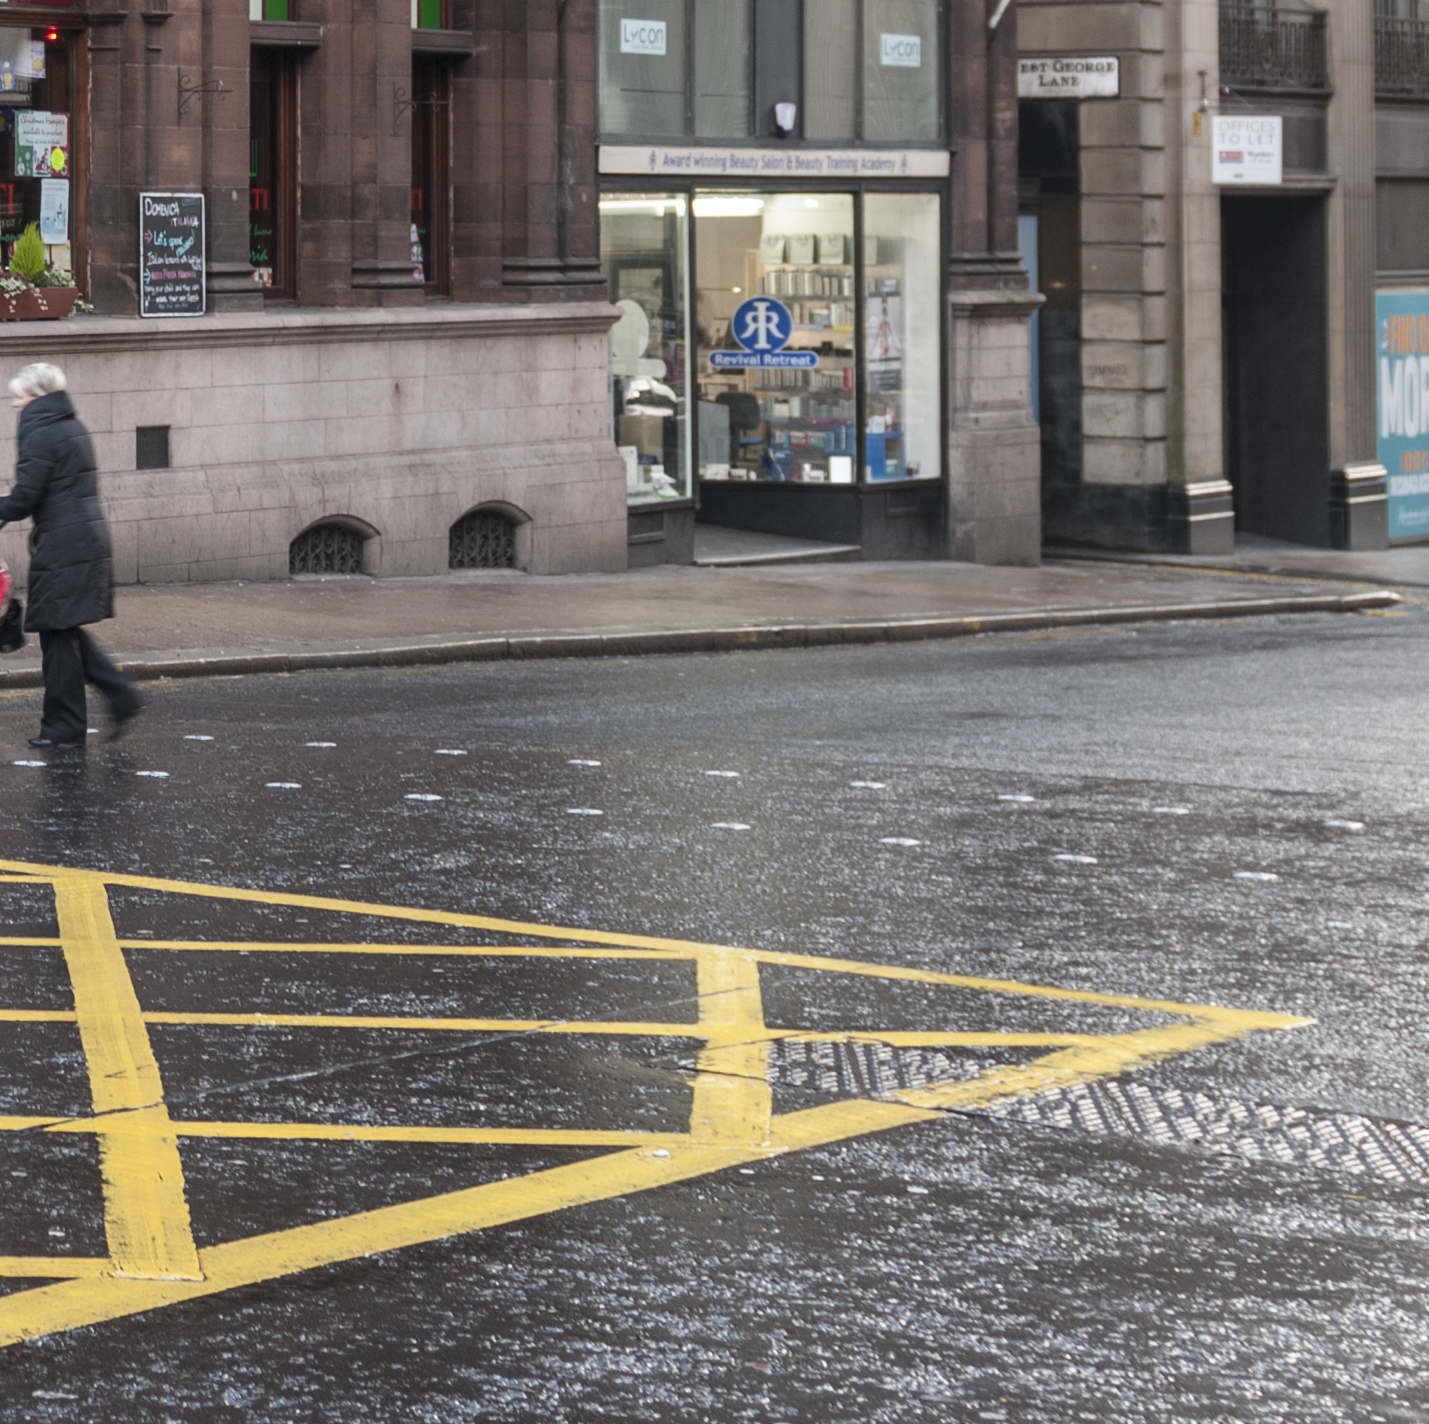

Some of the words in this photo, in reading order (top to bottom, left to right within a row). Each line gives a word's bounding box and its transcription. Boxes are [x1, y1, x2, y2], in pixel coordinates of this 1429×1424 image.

[1053, 60, 1115, 74] GEORGE
[1038, 74, 1080, 87] LANE
[1219, 120, 1276, 133] OFFICES
[1219, 133, 1240, 145] TO
[1248, 133, 1274, 145] LET
[662, 153, 691, 168] Award
[693, 153, 728, 172] winning
[729, 153, 759, 173] Beauty
[761, 154, 785, 170] Salon
[795, 155, 823, 173] Beauty
[826, 155, 858, 173] Training
[860, 156, 896, 173] Academy
[714, 354, 761, 365] Revival
[764, 354, 812, 366] Retreat
